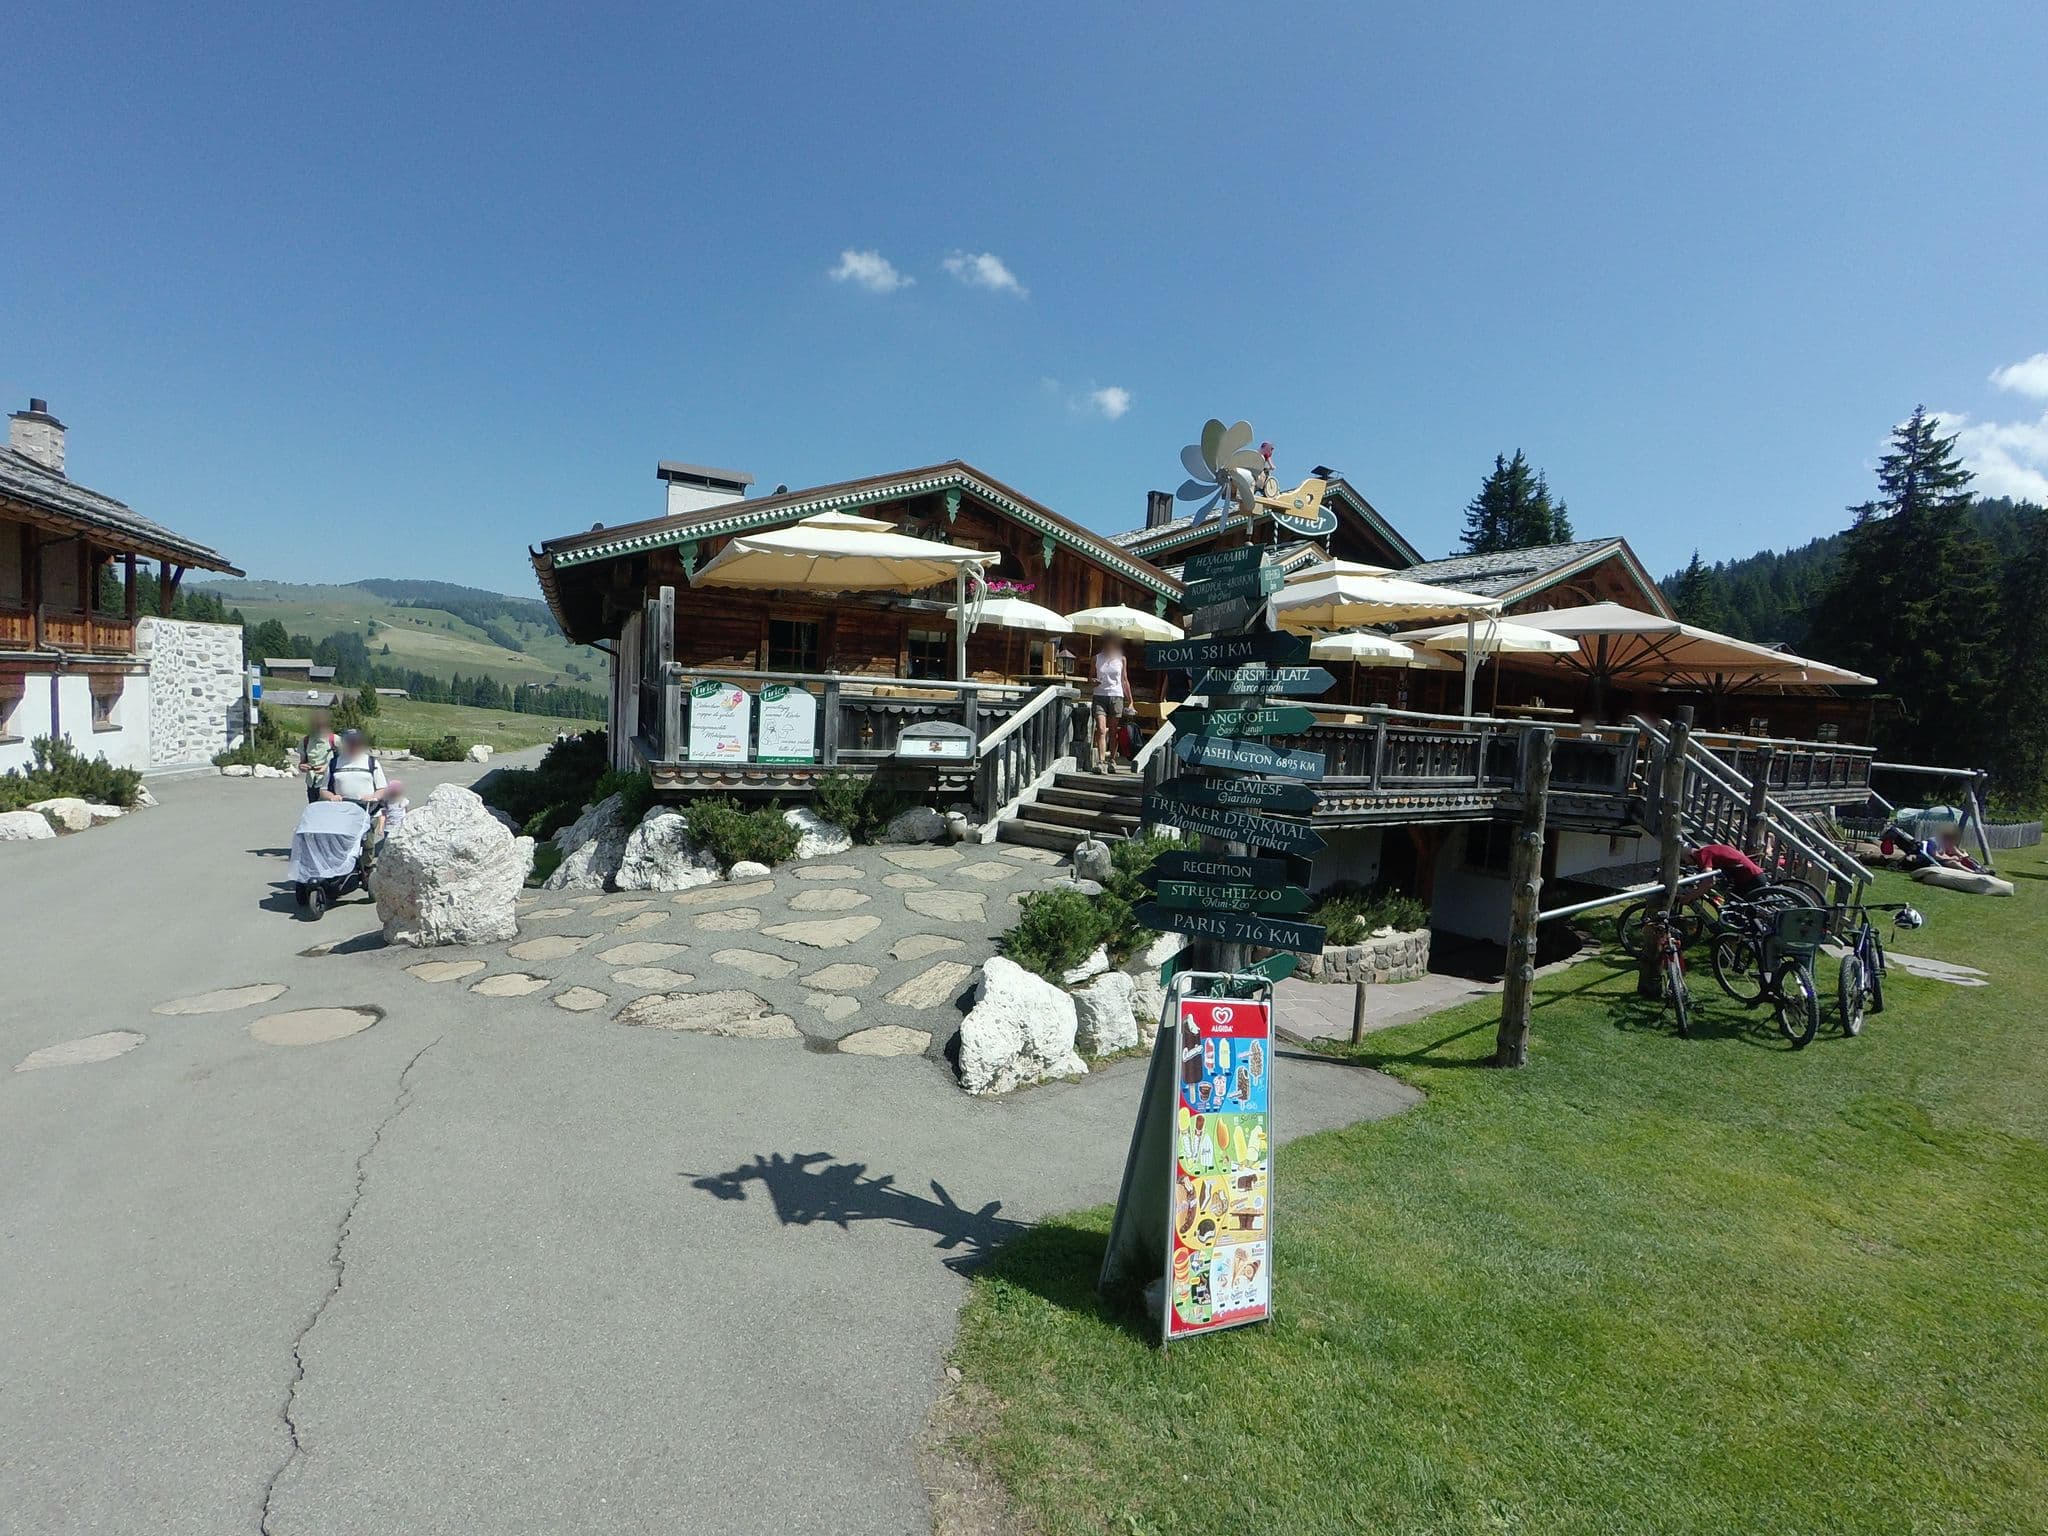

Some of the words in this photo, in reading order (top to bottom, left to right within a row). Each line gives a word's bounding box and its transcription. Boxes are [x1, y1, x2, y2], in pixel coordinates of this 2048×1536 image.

[1195, 550, 1249, 568] HEXAGRAMM
[1158, 647, 1194, 663] ROM
[1201, 645, 1223, 660] 581
[1227, 642, 1253, 657] KM
[1206, 669, 1311, 681] KINDERSPIELPLATZ
[1233, 681, 1259, 694] Parco
[1202, 711, 1279, 725] LANGKOFEL
[1191, 745, 1272, 765] WASHINGTON
[1275, 756, 1298, 771] 6895
[1300, 760, 1316, 772] KM
[1204, 778, 1283, 797] LIEGEWIESE
[1217, 791, 1262, 805] Giardino
[1150, 796, 1220, 821] TRENKER
[1224, 812, 1307, 840] DENKMAL
[1160, 812, 1238, 840] Monumento
[1242, 828, 1291, 852] Trenker
[1183, 860, 1252, 878] RECEPTION
[1171, 884, 1282, 901] STREICHELZOO
[1202, 896, 1250, 910] Mini-Zoo
[1174, 913, 1227, 935] PARIS
[1235, 923, 1263, 940] 716
[1269, 928, 1301, 946] KM
[1211, 1025, 1232, 1033] ALGIDA
